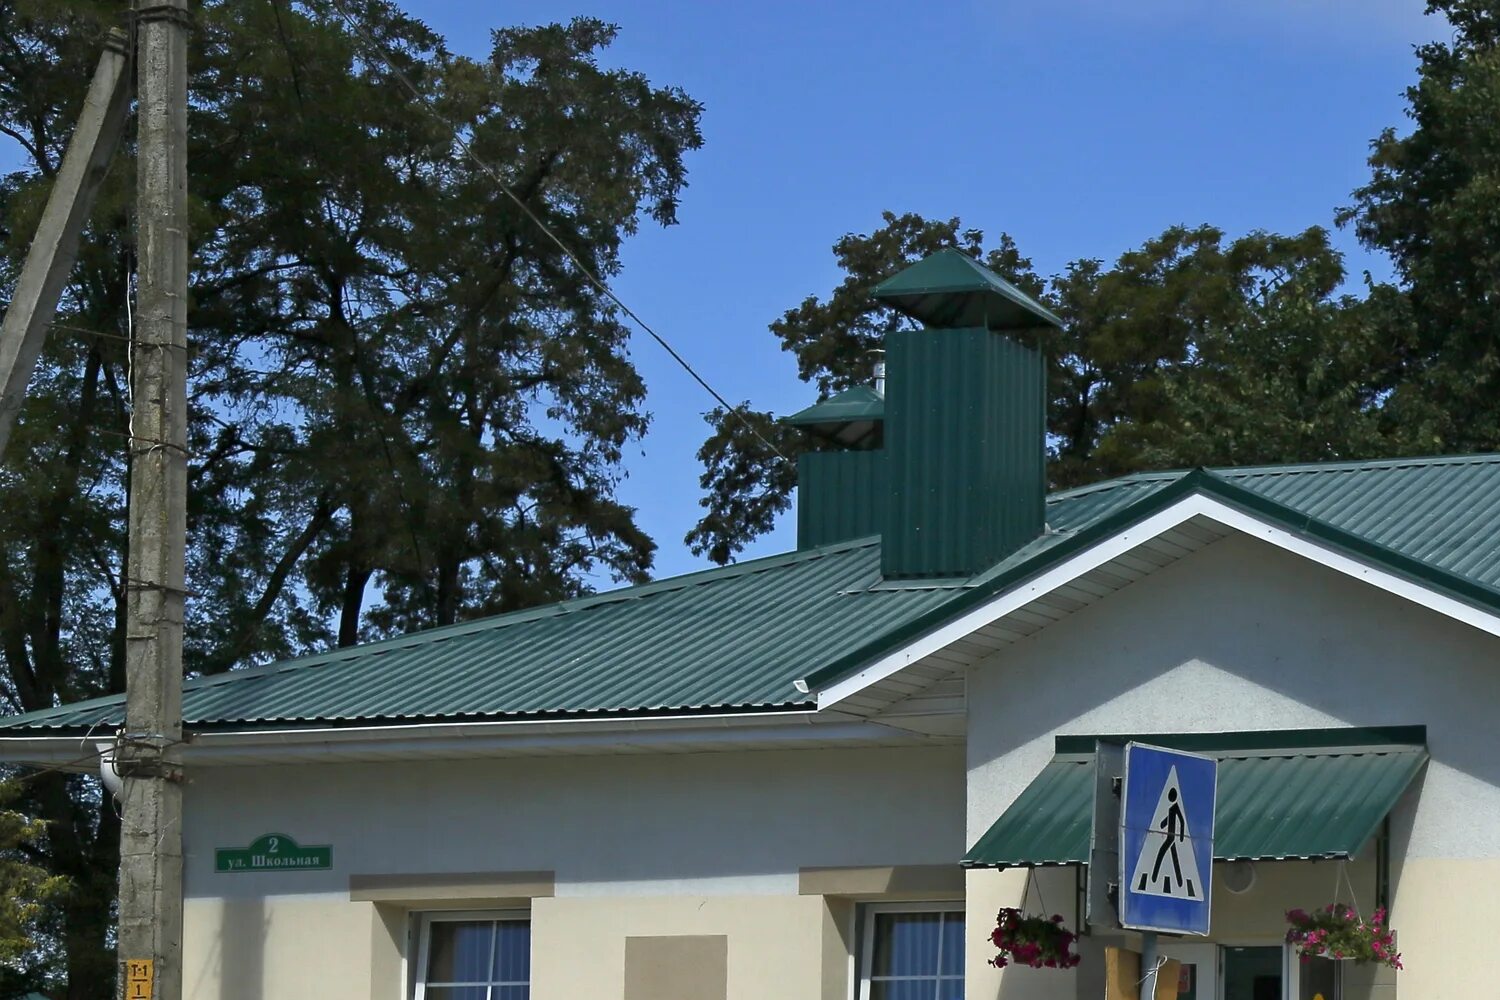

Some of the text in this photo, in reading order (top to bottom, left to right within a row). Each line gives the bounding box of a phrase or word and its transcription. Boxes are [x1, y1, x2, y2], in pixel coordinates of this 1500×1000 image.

[268, 836, 279, 853] 2
[227, 855, 320, 870] ул. Школьная
